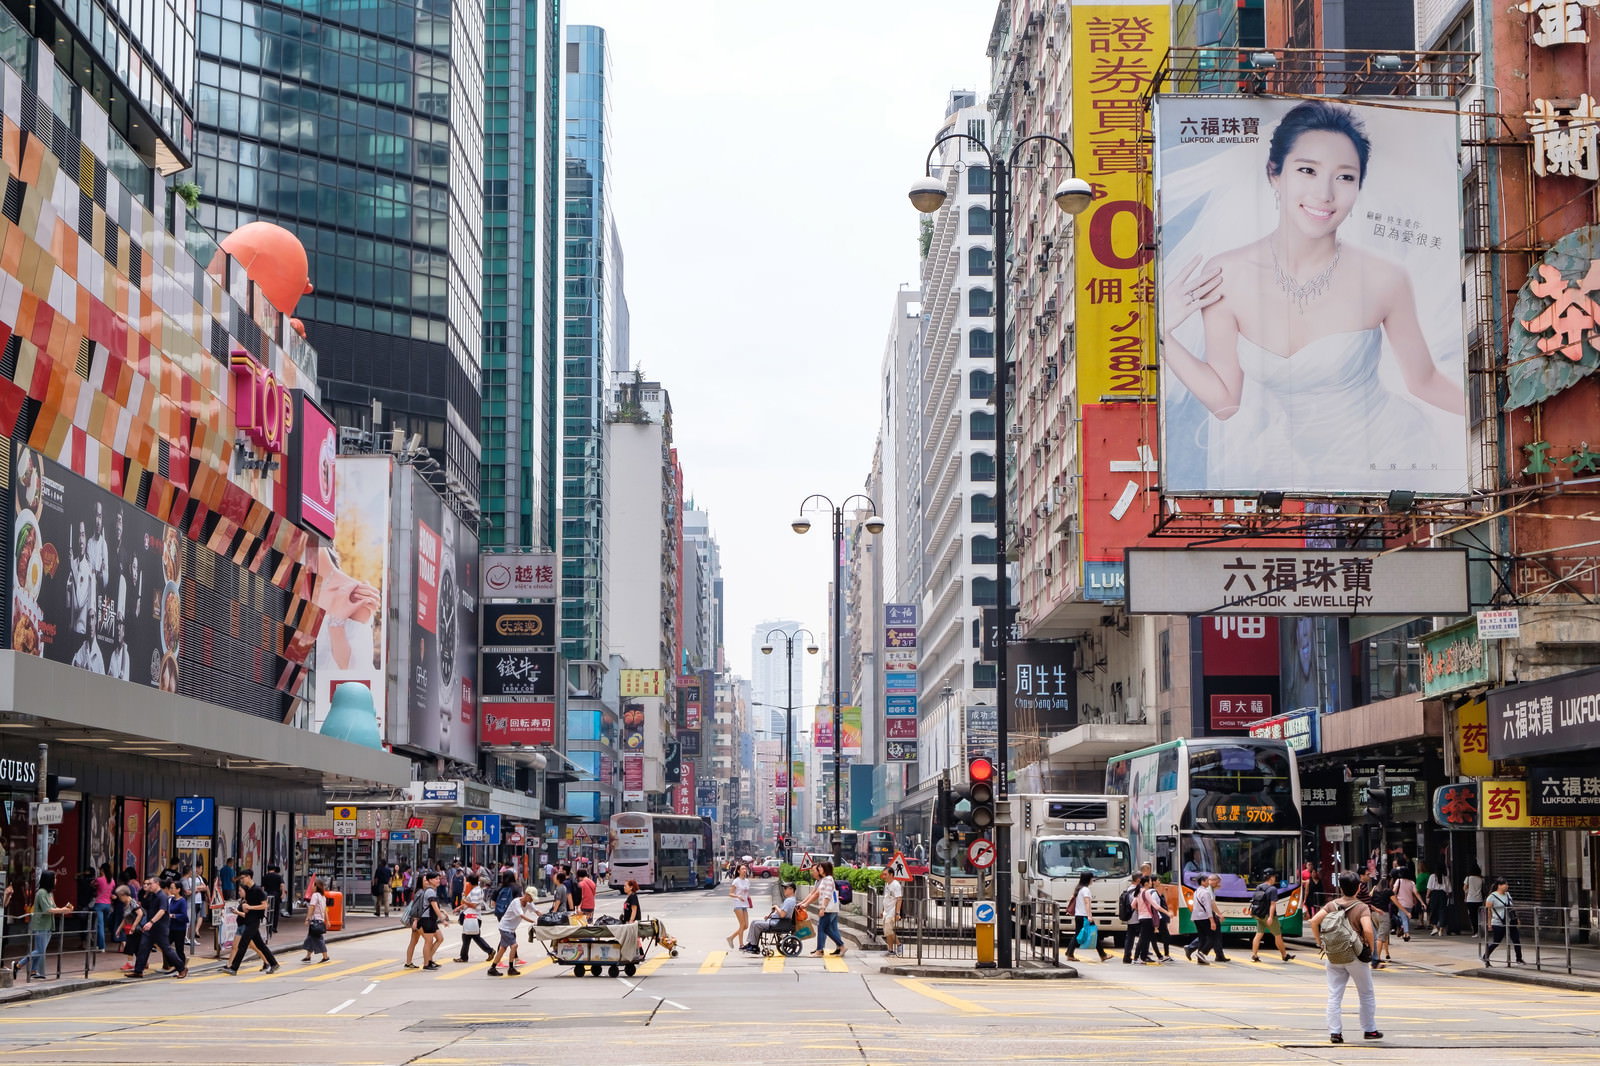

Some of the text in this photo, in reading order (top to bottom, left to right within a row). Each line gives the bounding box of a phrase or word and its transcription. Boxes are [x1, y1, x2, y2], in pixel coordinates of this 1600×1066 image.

[1180, 117, 1260, 136] 六福珠寶
[1374, 223, 1441, 250] 因為愛很美
[1085, 277, 1155, 304] 佣金
[231, 351, 293, 453] TOP
[1223, 557, 1374, 593] 六福珠寶
[1223, 596, 1374, 607] LUKFOOK JEWELLERY
[1015, 664, 1067, 695] 周生生
[1219, 700, 1264, 713] 周大福
[1502, 696, 1553, 740] 六福珠寶
[1463, 723, 1488, 753] 药
[1, 758, 35, 783] GUESS
[1542, 777, 1600, 796] 六福珠
[1442, 787, 1478, 823] 茶
[1488, 787, 1520, 820] 药
